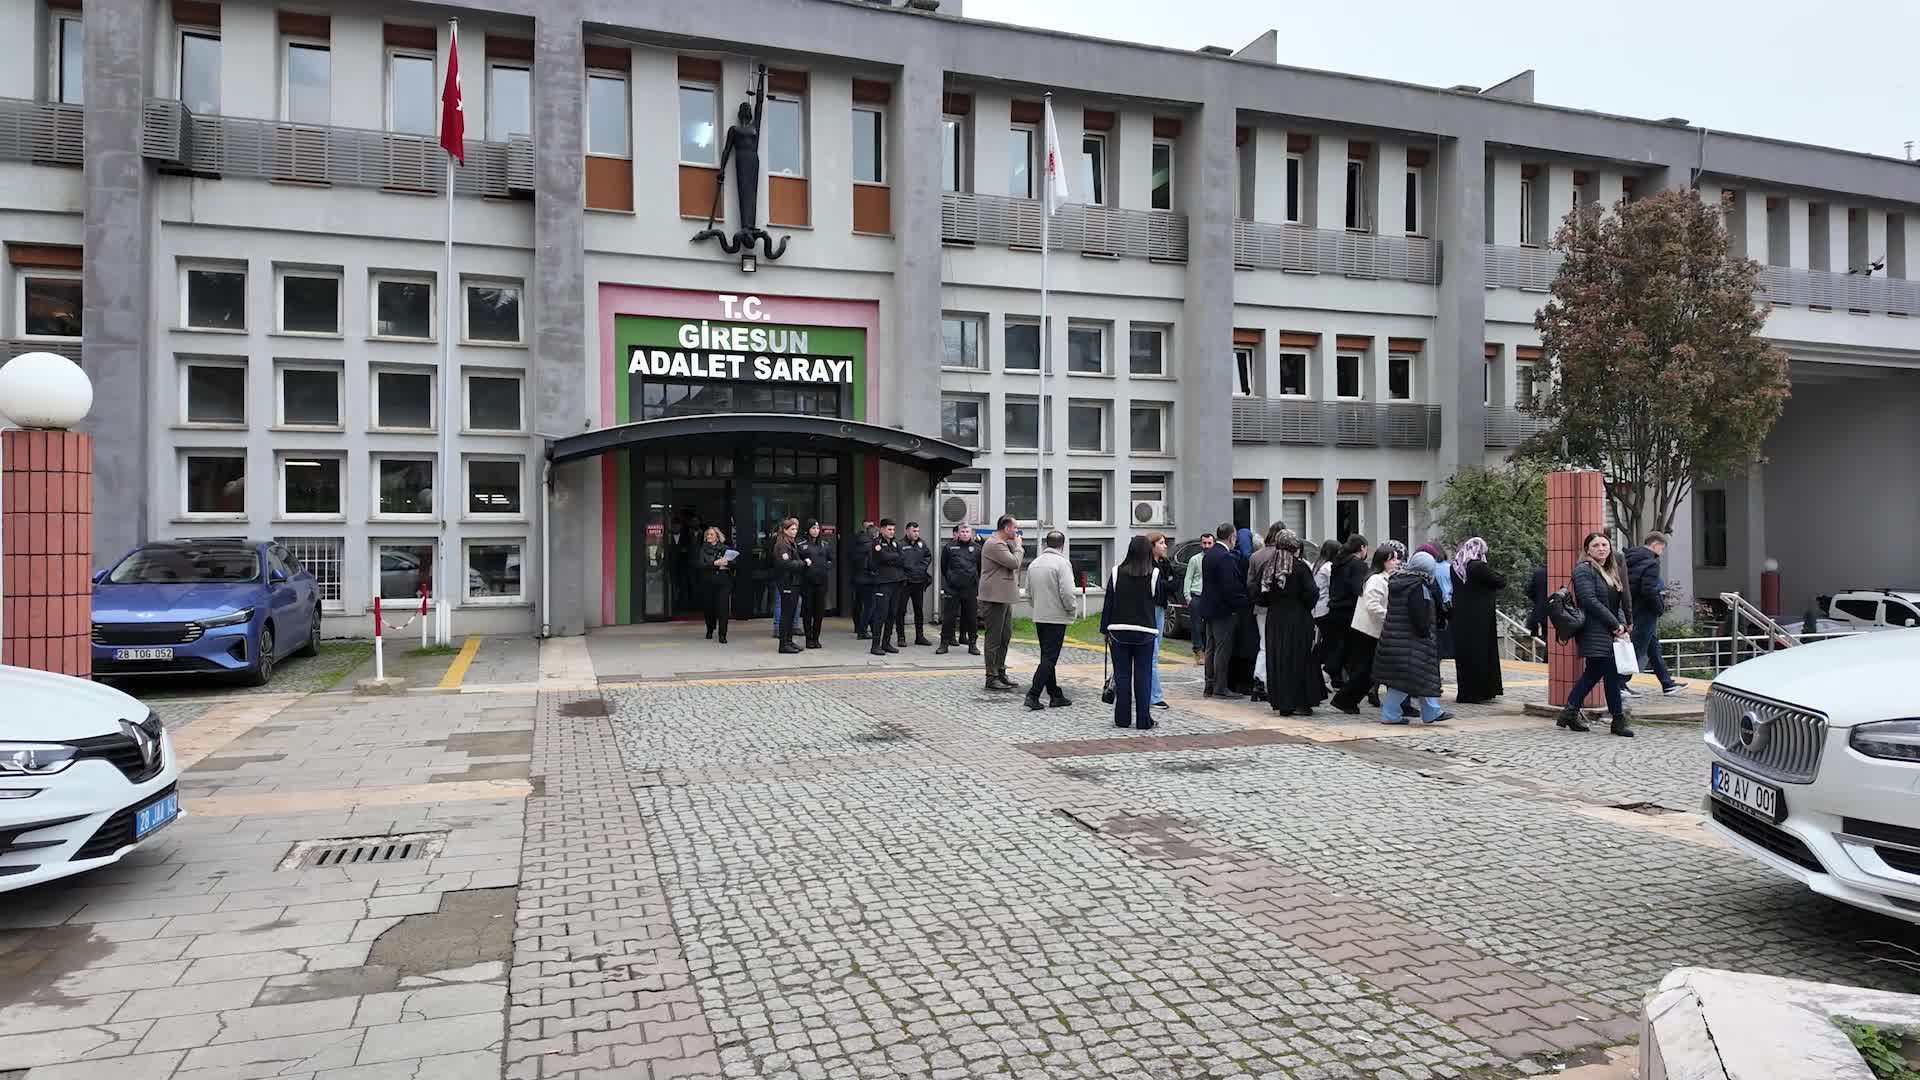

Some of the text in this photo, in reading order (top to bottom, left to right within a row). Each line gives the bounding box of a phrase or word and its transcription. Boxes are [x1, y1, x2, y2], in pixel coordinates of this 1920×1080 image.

[719, 295, 770, 320] T.C.
[679, 320, 808, 353] GİRESUN
[628, 350, 853, 383] ADALET SARAYI
[118, 648, 172, 658] 28 TOG 052
[1719, 770, 1774, 815] 28 AV 001
[140, 810, 150, 831] 28
